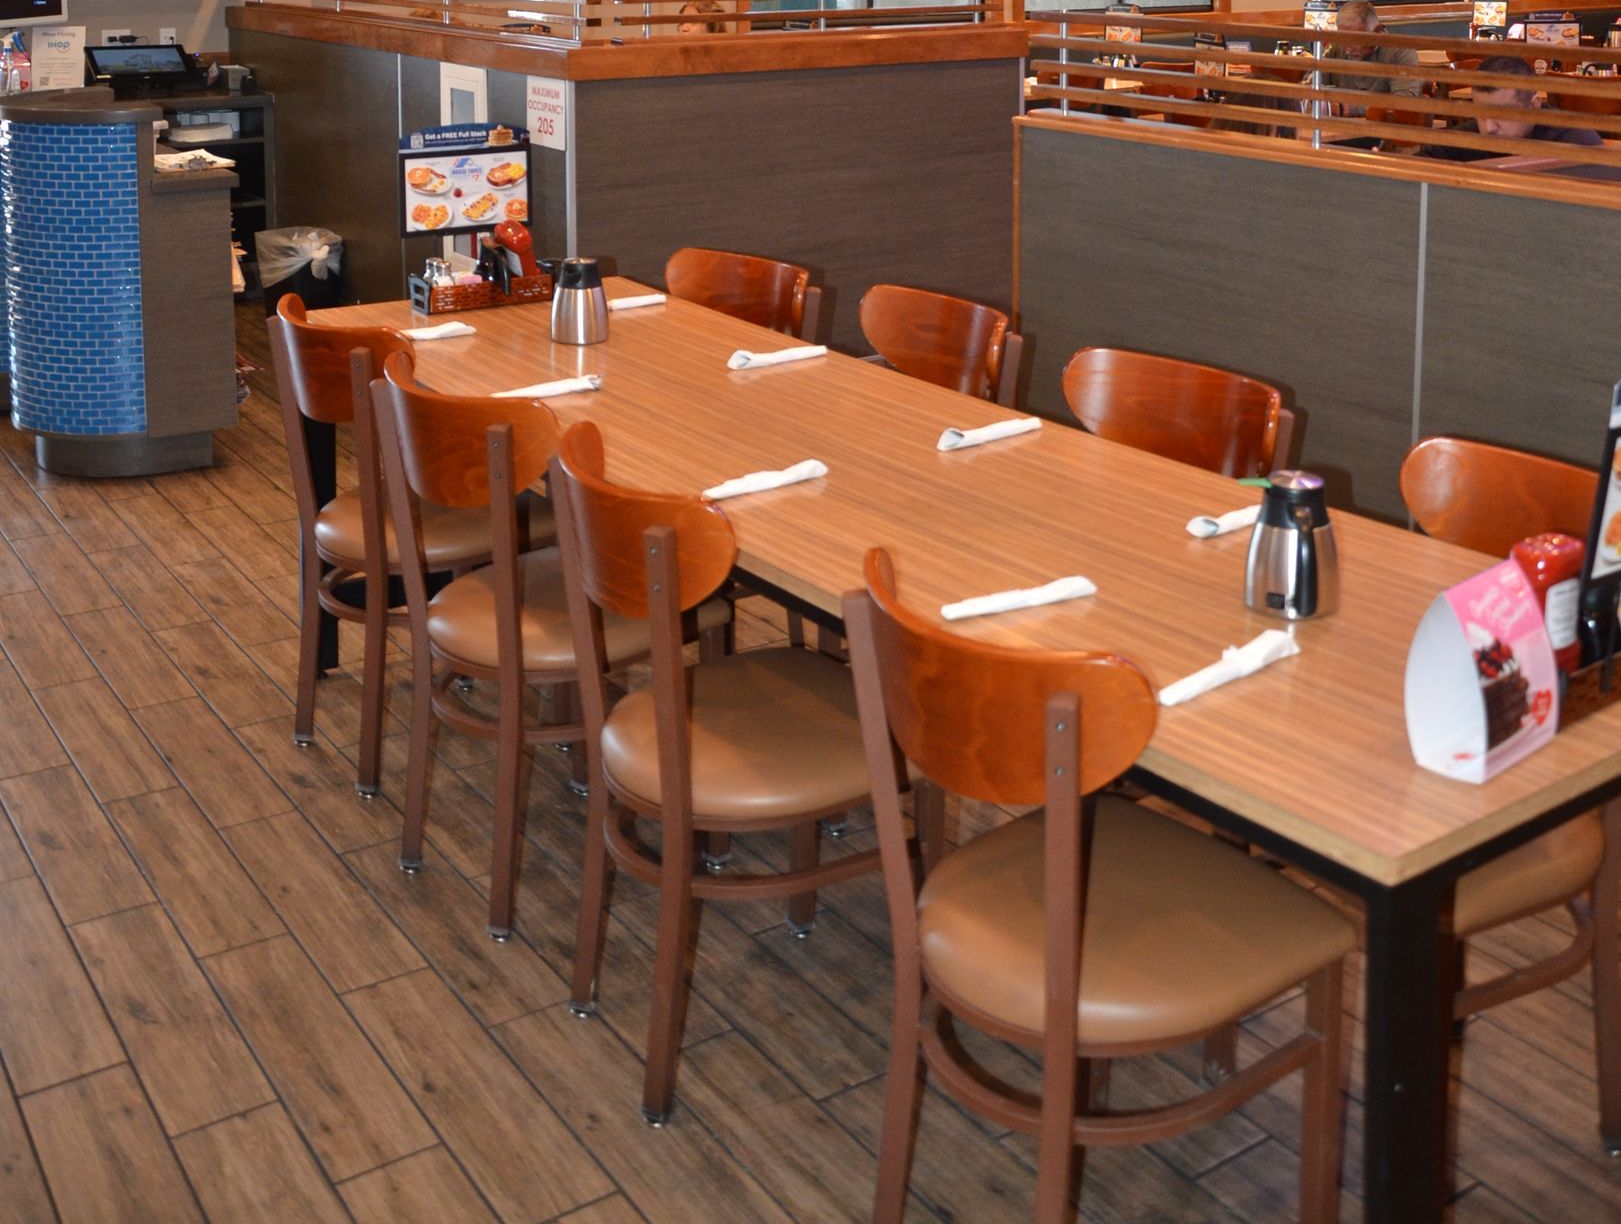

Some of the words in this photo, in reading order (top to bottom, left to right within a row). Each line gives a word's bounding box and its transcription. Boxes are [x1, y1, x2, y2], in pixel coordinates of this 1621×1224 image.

[532, 86, 560, 99] MAXIMUM
[528, 99, 563, 115] OCCUPANCY
[537, 117, 554, 136] 205
[425, 133, 436, 141] Get
[441, 132, 457, 140] FREE
[470, 130, 487, 138] Stack
